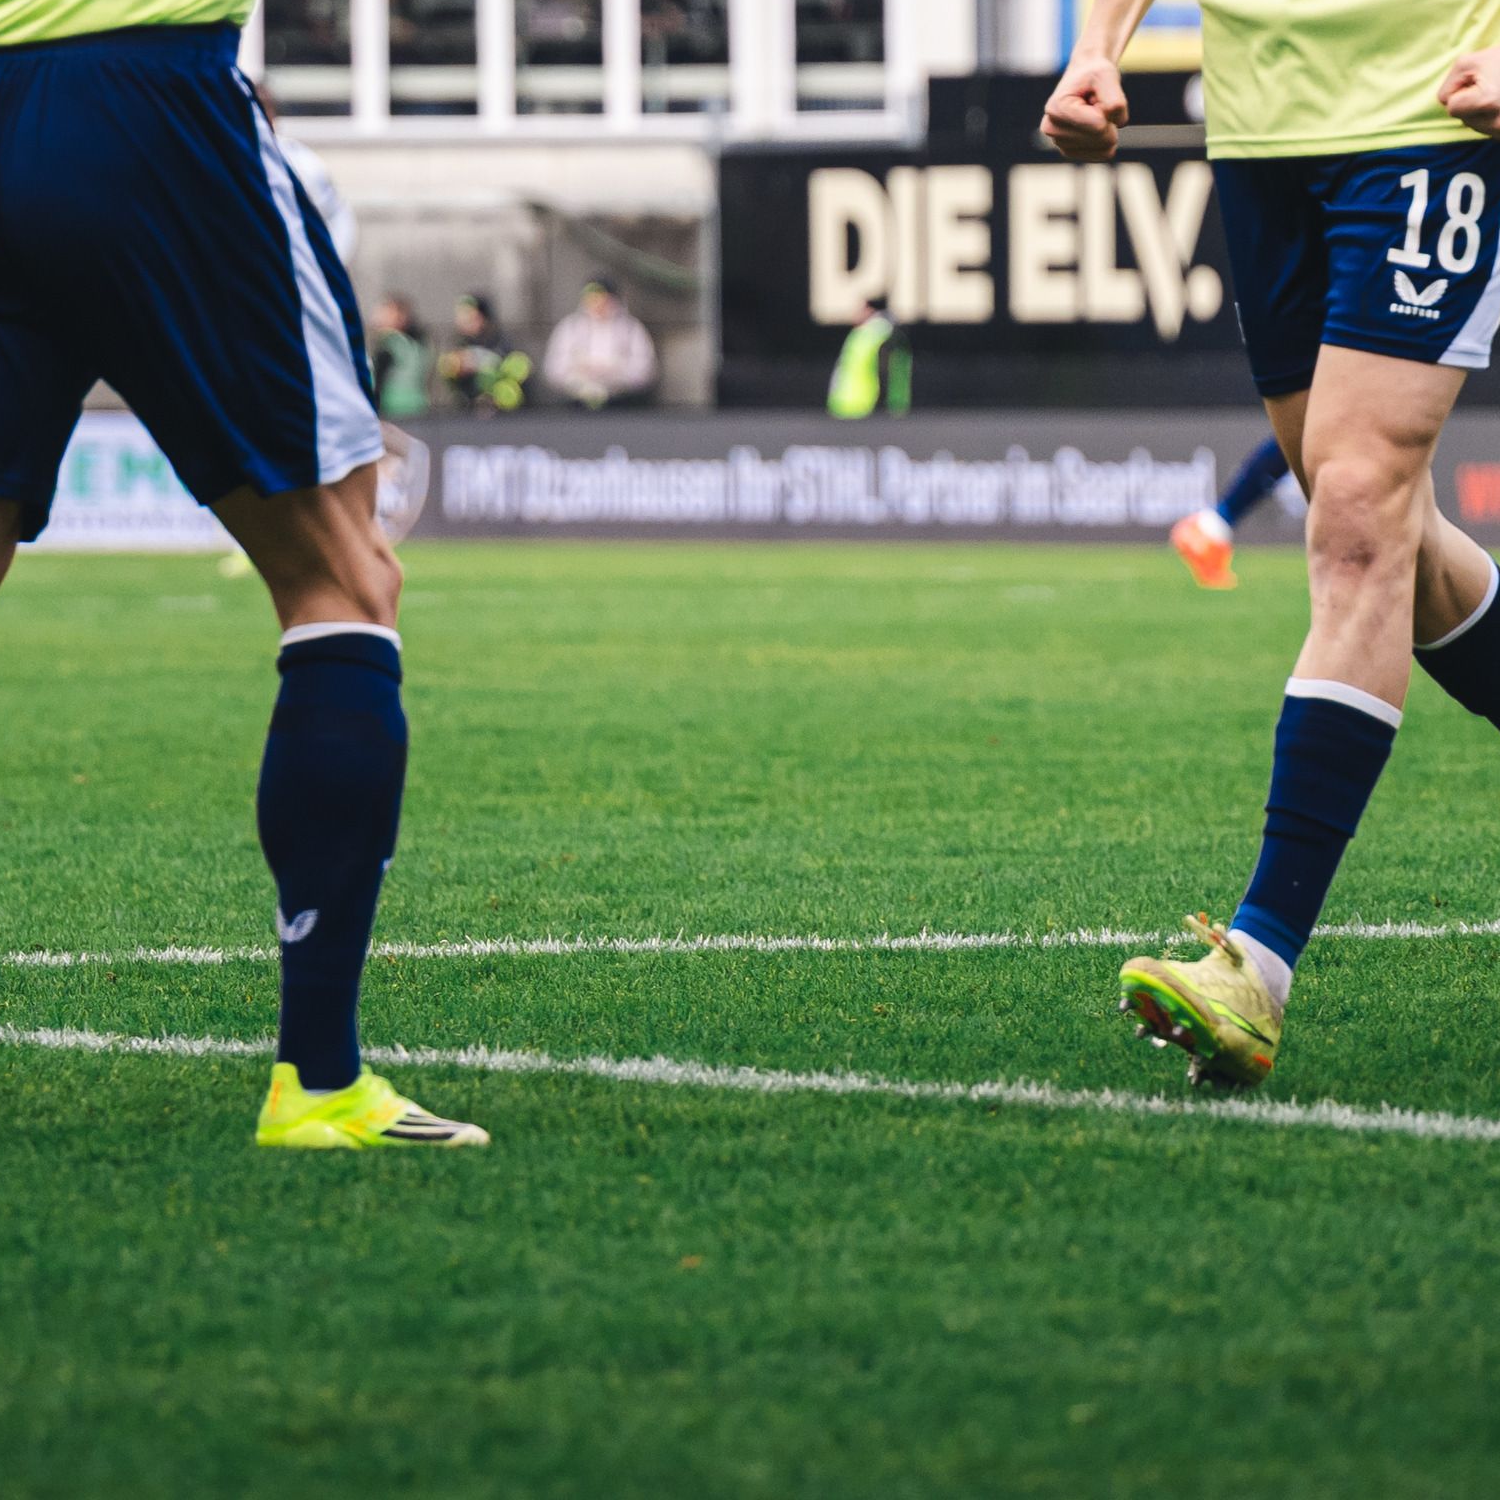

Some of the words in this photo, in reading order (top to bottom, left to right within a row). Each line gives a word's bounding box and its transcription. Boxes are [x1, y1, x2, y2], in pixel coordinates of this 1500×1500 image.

[809, 164, 993, 324] DIE
[1009, 160, 1222, 341] ELV.
[1387, 168, 1486, 274] 18
